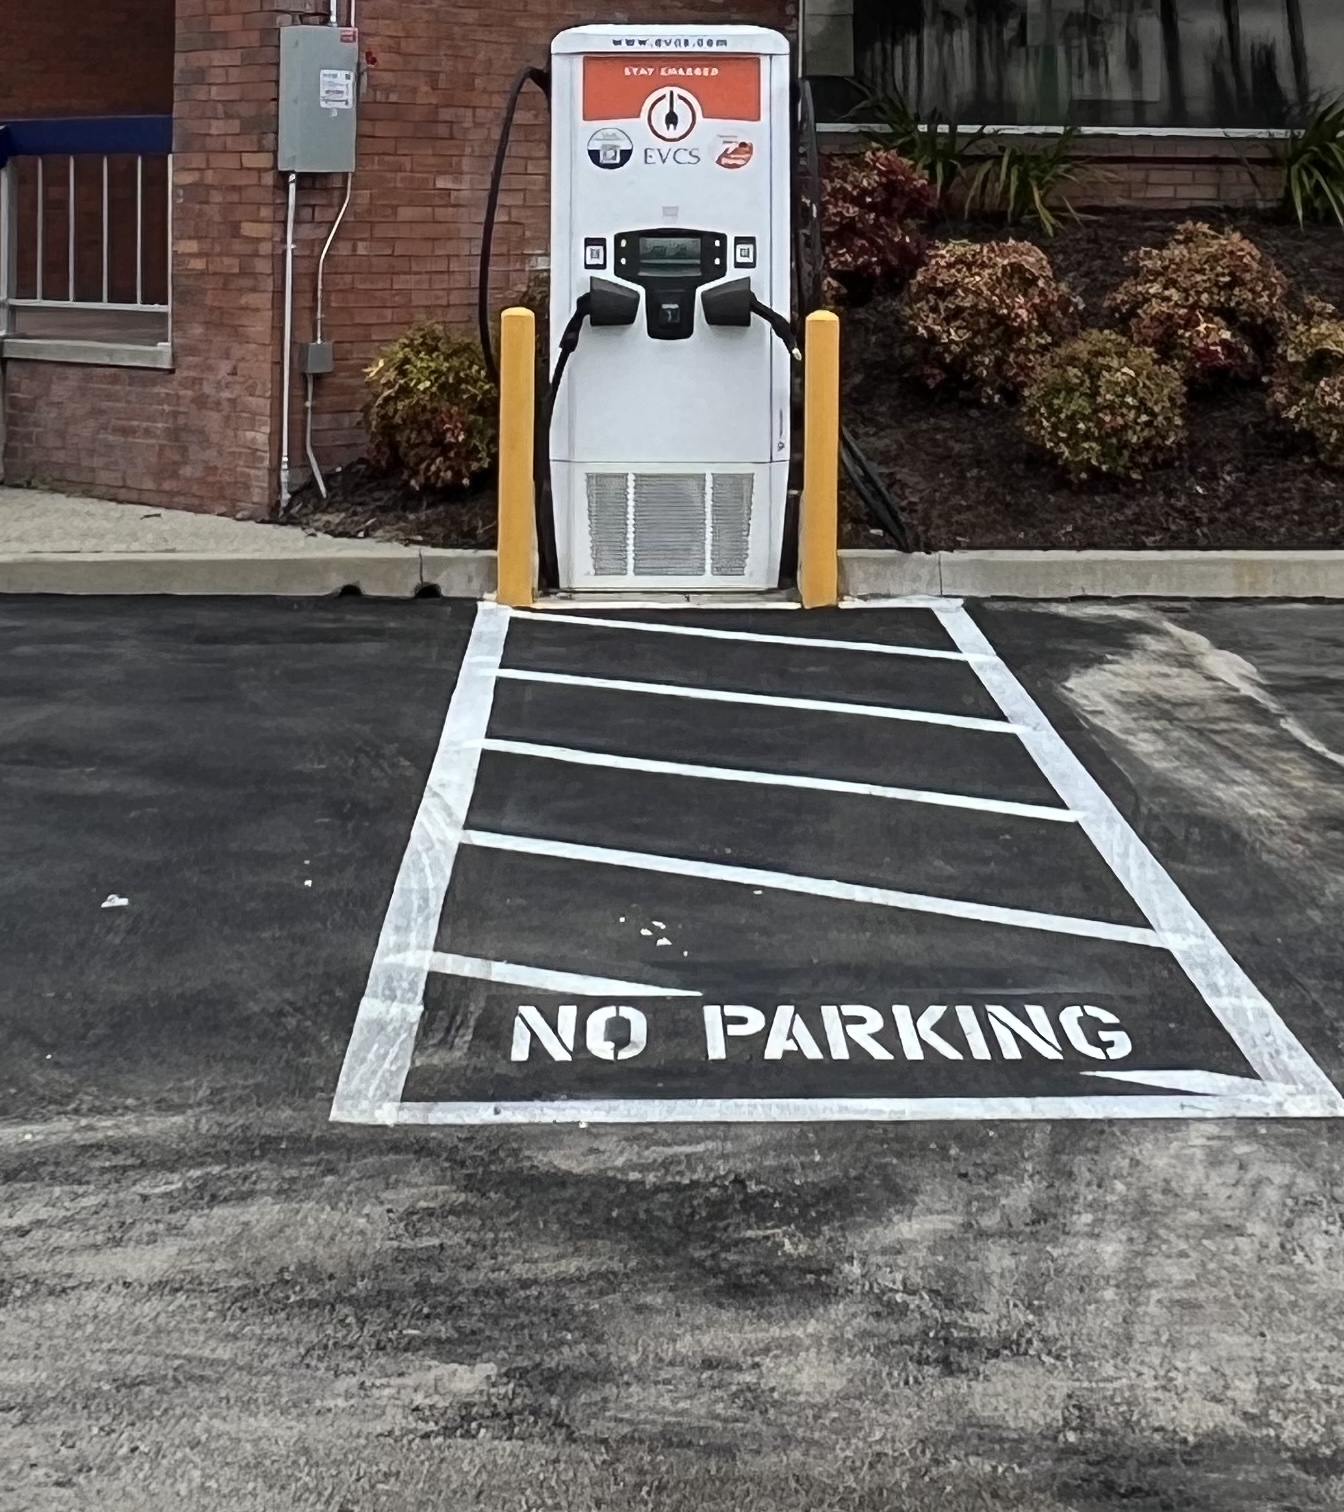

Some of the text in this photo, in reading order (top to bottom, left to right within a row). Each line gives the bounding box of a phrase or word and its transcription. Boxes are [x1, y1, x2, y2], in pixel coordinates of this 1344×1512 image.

[643, 148, 701, 165] EVCS
[509, 1004, 1133, 1062] NO PARKING
